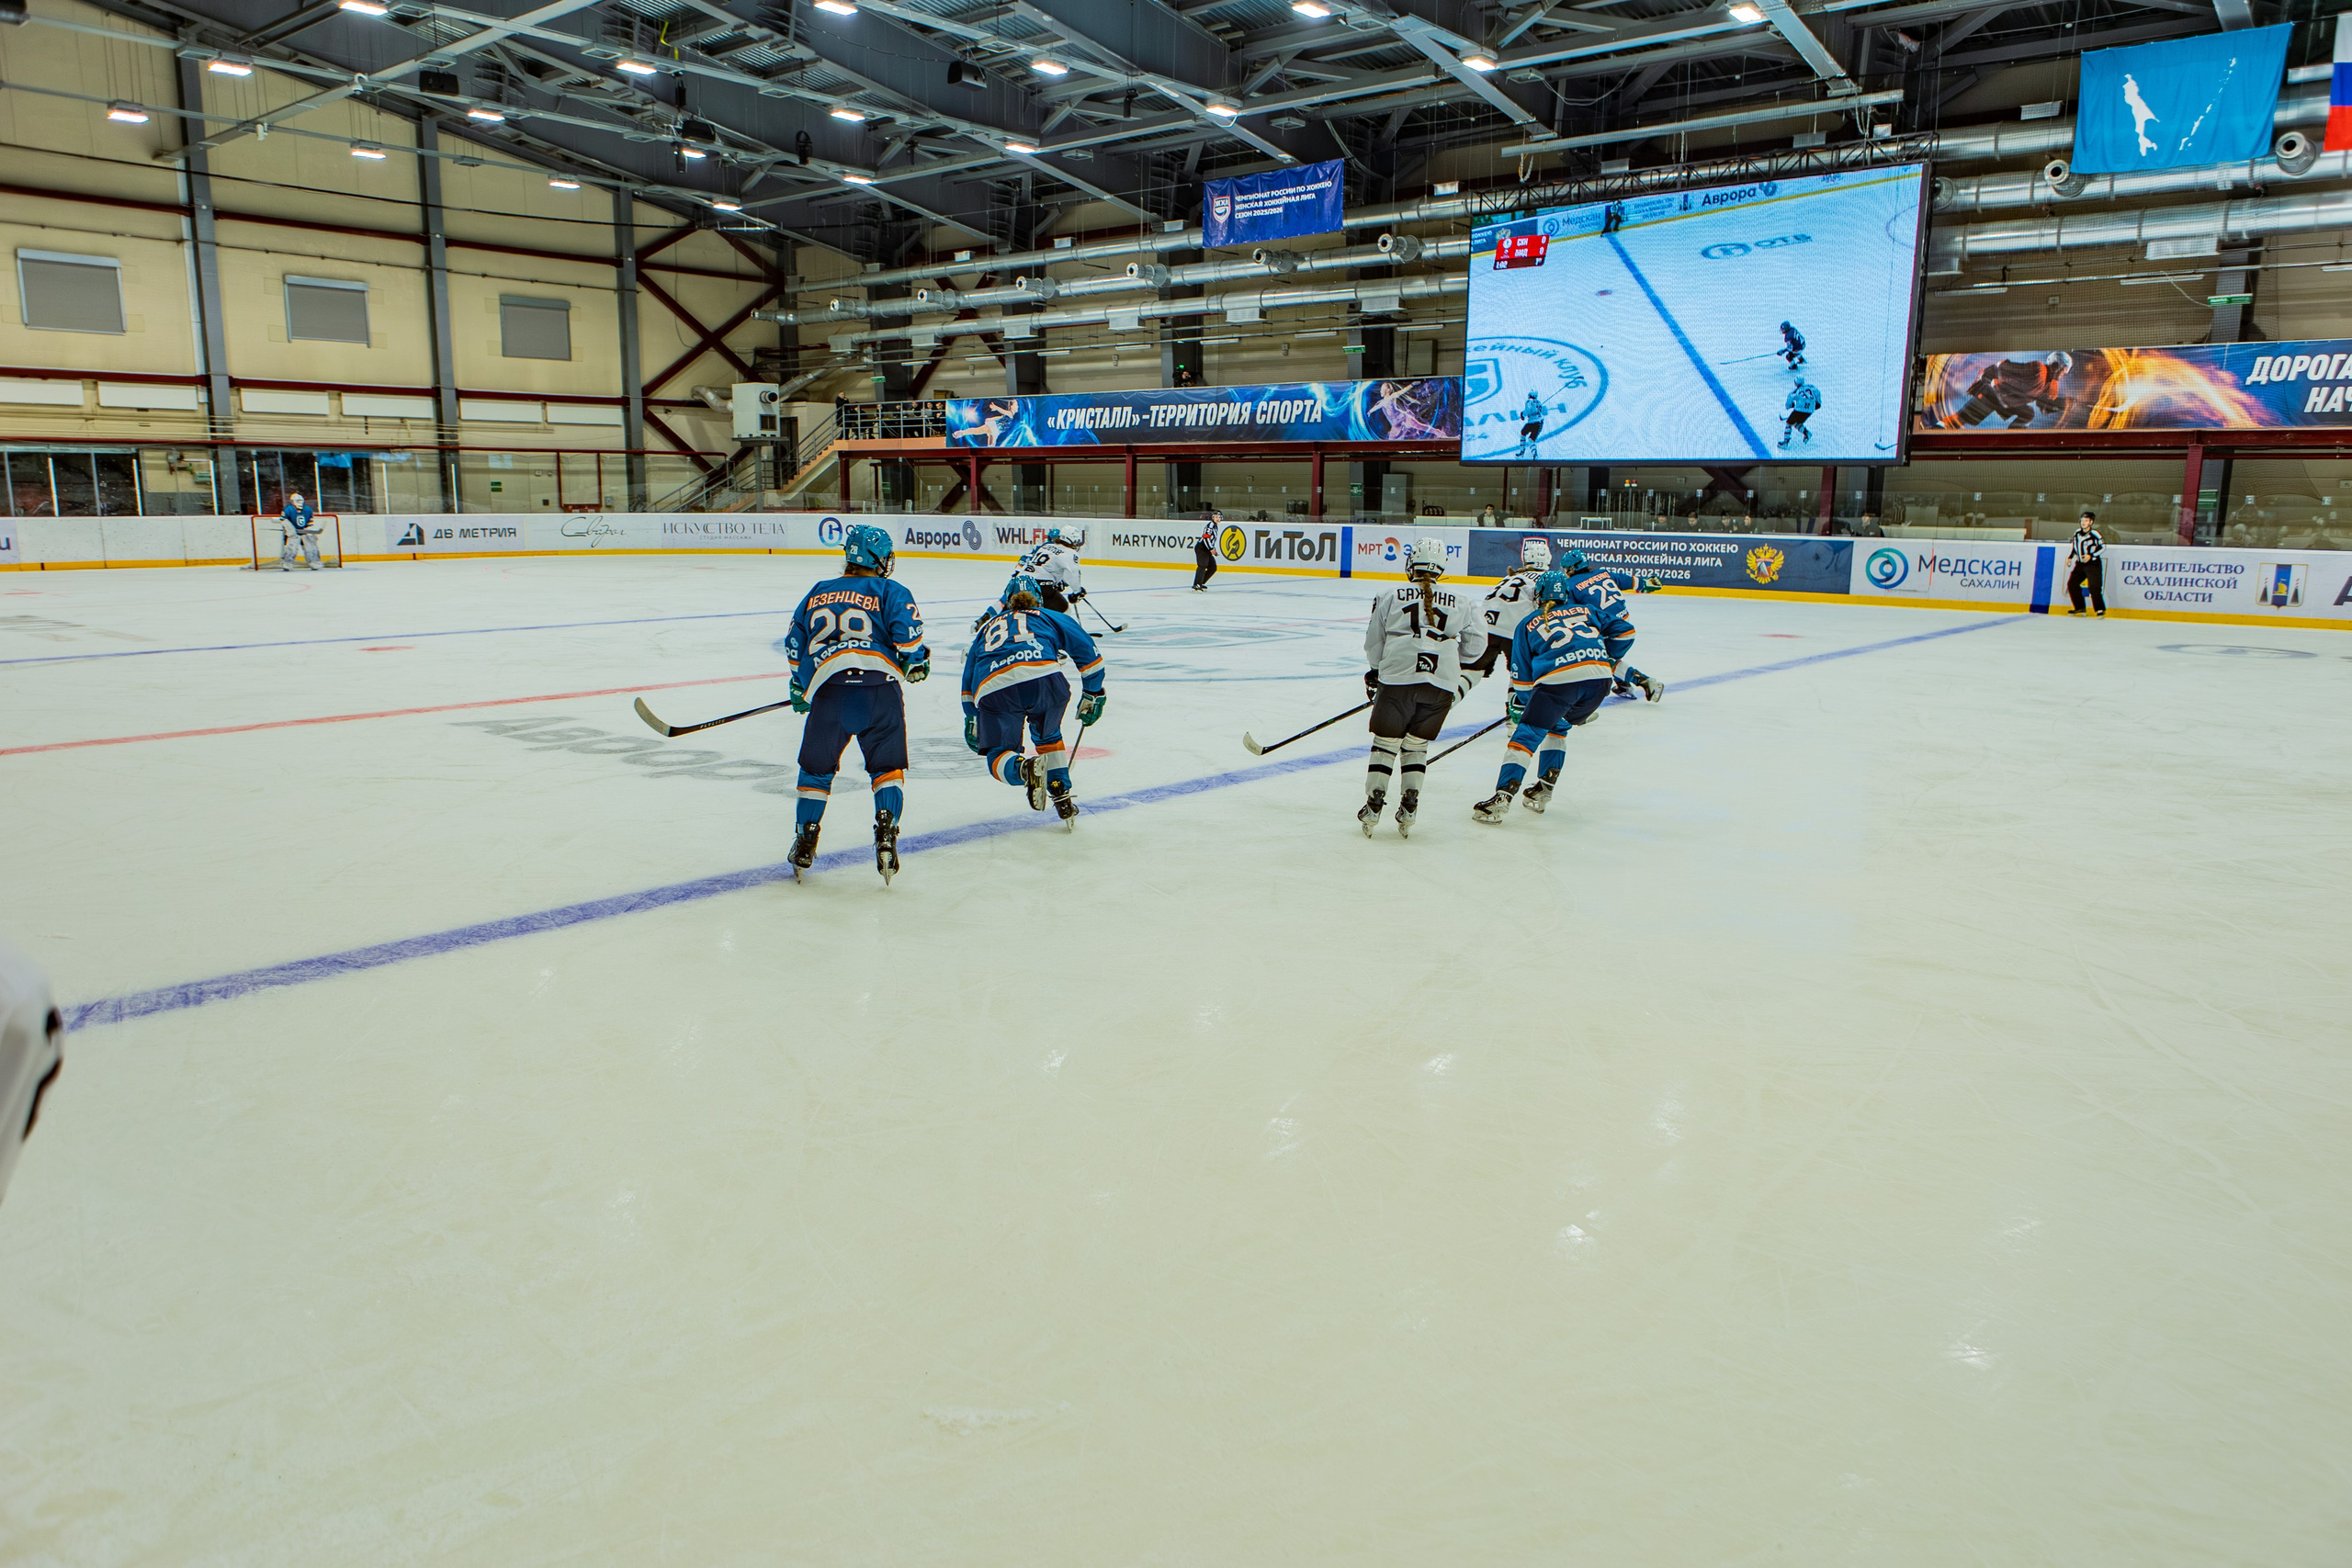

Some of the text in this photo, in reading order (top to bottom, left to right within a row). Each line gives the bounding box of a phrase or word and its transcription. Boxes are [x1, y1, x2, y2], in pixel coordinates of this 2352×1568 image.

[1235, 181, 1332, 202] ЧЕМПИОНАТ РОССИИ ПО ХОККЕЮ
[1702, 187, 1756, 207] Аврора
[1235, 193, 1316, 210] ЖЕНСКАЯ ХОККЕЙНАЯ ЛИГА
[1235, 207, 1283, 219] СЕЗОН 2025/2026
[1255, 399, 1323, 424] СПОРТА
[458, 527, 516, 538] МЕТРИЯ
[750, 523, 786, 535] ТЕЛА
[905, 527, 961, 548] Аврора
[850, 545, 858, 555] 28
[1358, 543, 1383, 556] МРТ
[1556, 539, 1622, 550] ЧЕМПИОНАТ
[1623, 540, 1668, 551] РОССИИ
[1670, 542, 1687, 552] ПО
[1689, 542, 1738, 553] ХОККЕЮ
[1426, 562, 1436, 570] 13
[1623, 551, 1691, 566] ХОККЕЙНАЯ
[1693, 557, 1723, 567] ЛИГА
[1917, 555, 2021, 576] Медскан
[1635, 568, 1690, 580] 2025/2026
[2120, 560, 2245, 575] ПРАВИТЕЛЬСТВО
[1553, 582, 1562, 592] 55
[1960, 578, 2019, 590] САХАЛИН
[2123, 575, 2238, 589] САХАЛИНСКОЙ
[1589, 579, 1623, 610] 29
[2143, 591, 2213, 603] ОБЛАСТИ
[906, 603, 922, 621] 2
[808, 607, 873, 656] 28
[984, 612, 1035, 652] 81
[1536, 615, 1600, 649] 55
[813, 638, 871, 669] Аврора
[989, 649, 1043, 671] Аврора
